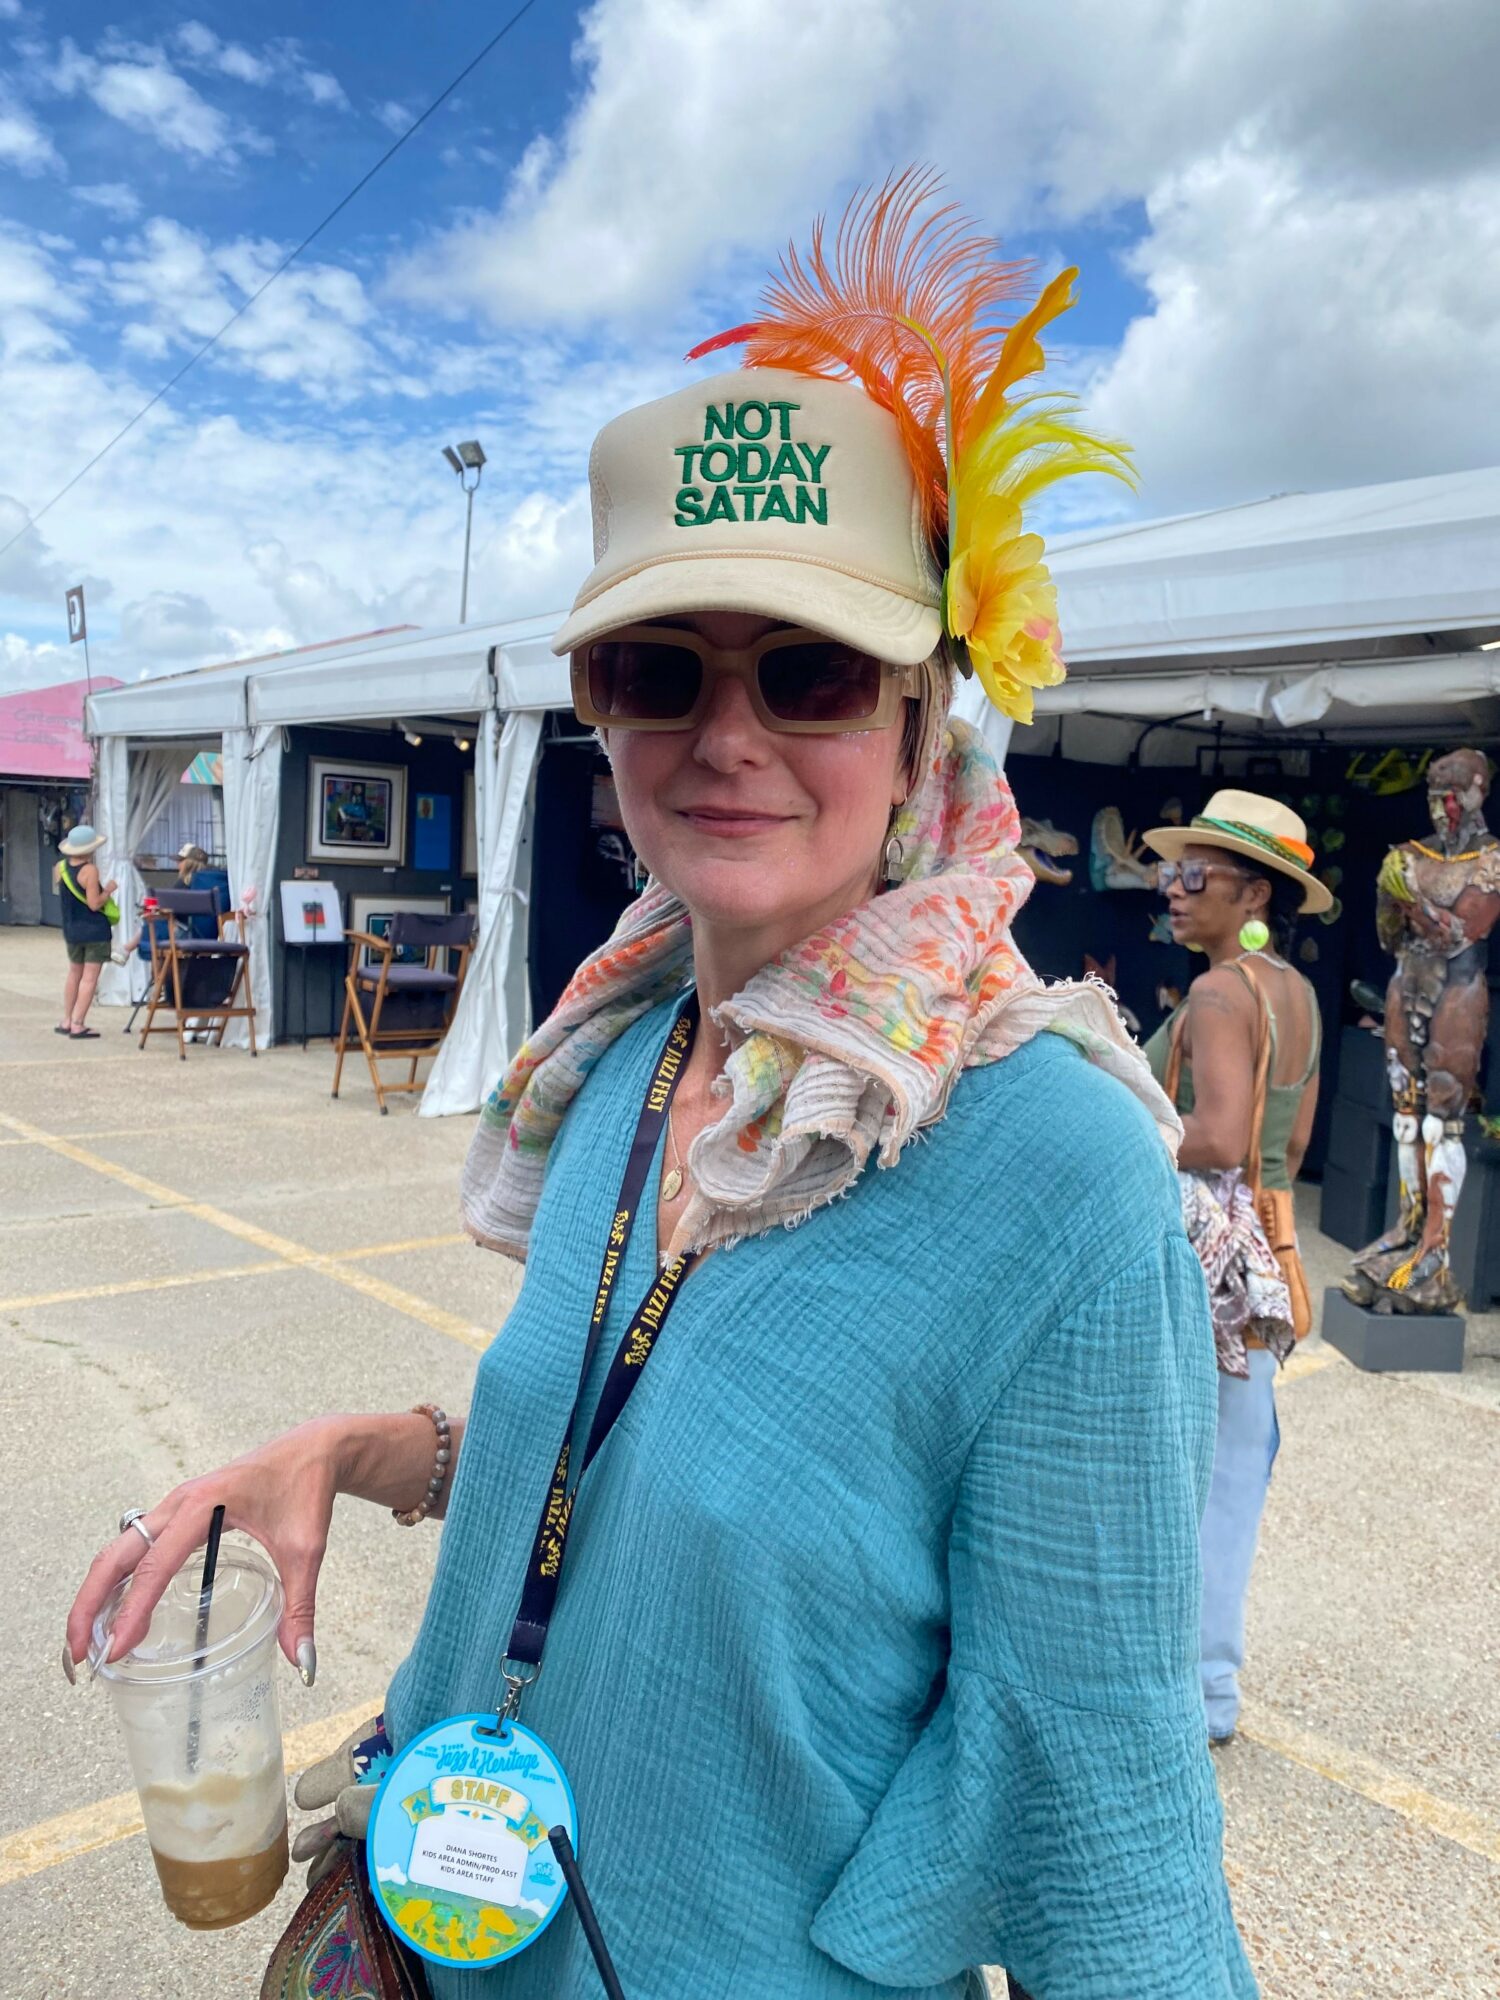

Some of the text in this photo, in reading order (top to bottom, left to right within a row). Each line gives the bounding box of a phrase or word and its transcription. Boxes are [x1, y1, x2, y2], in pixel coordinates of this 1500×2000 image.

[704, 401, 801, 441] NOT
[674, 442, 832, 484] TODAY
[674, 484, 828, 527] SATAN
[648, 1045, 683, 1112] JAZZ FEST
[593, 1249, 619, 1324] JAZZ FEST
[640, 1288, 669, 1329] JAZZ
[436, 1744, 539, 1778] Jazz & Heritage
[450, 1779, 512, 1808] STAFF
[422, 1849, 518, 1879] KIDS AREA ADMIN/PROD ASST
[445, 1844, 498, 1863] DIANA SHORTES
[440, 1865, 495, 1884] KIDS AREA STAFF
